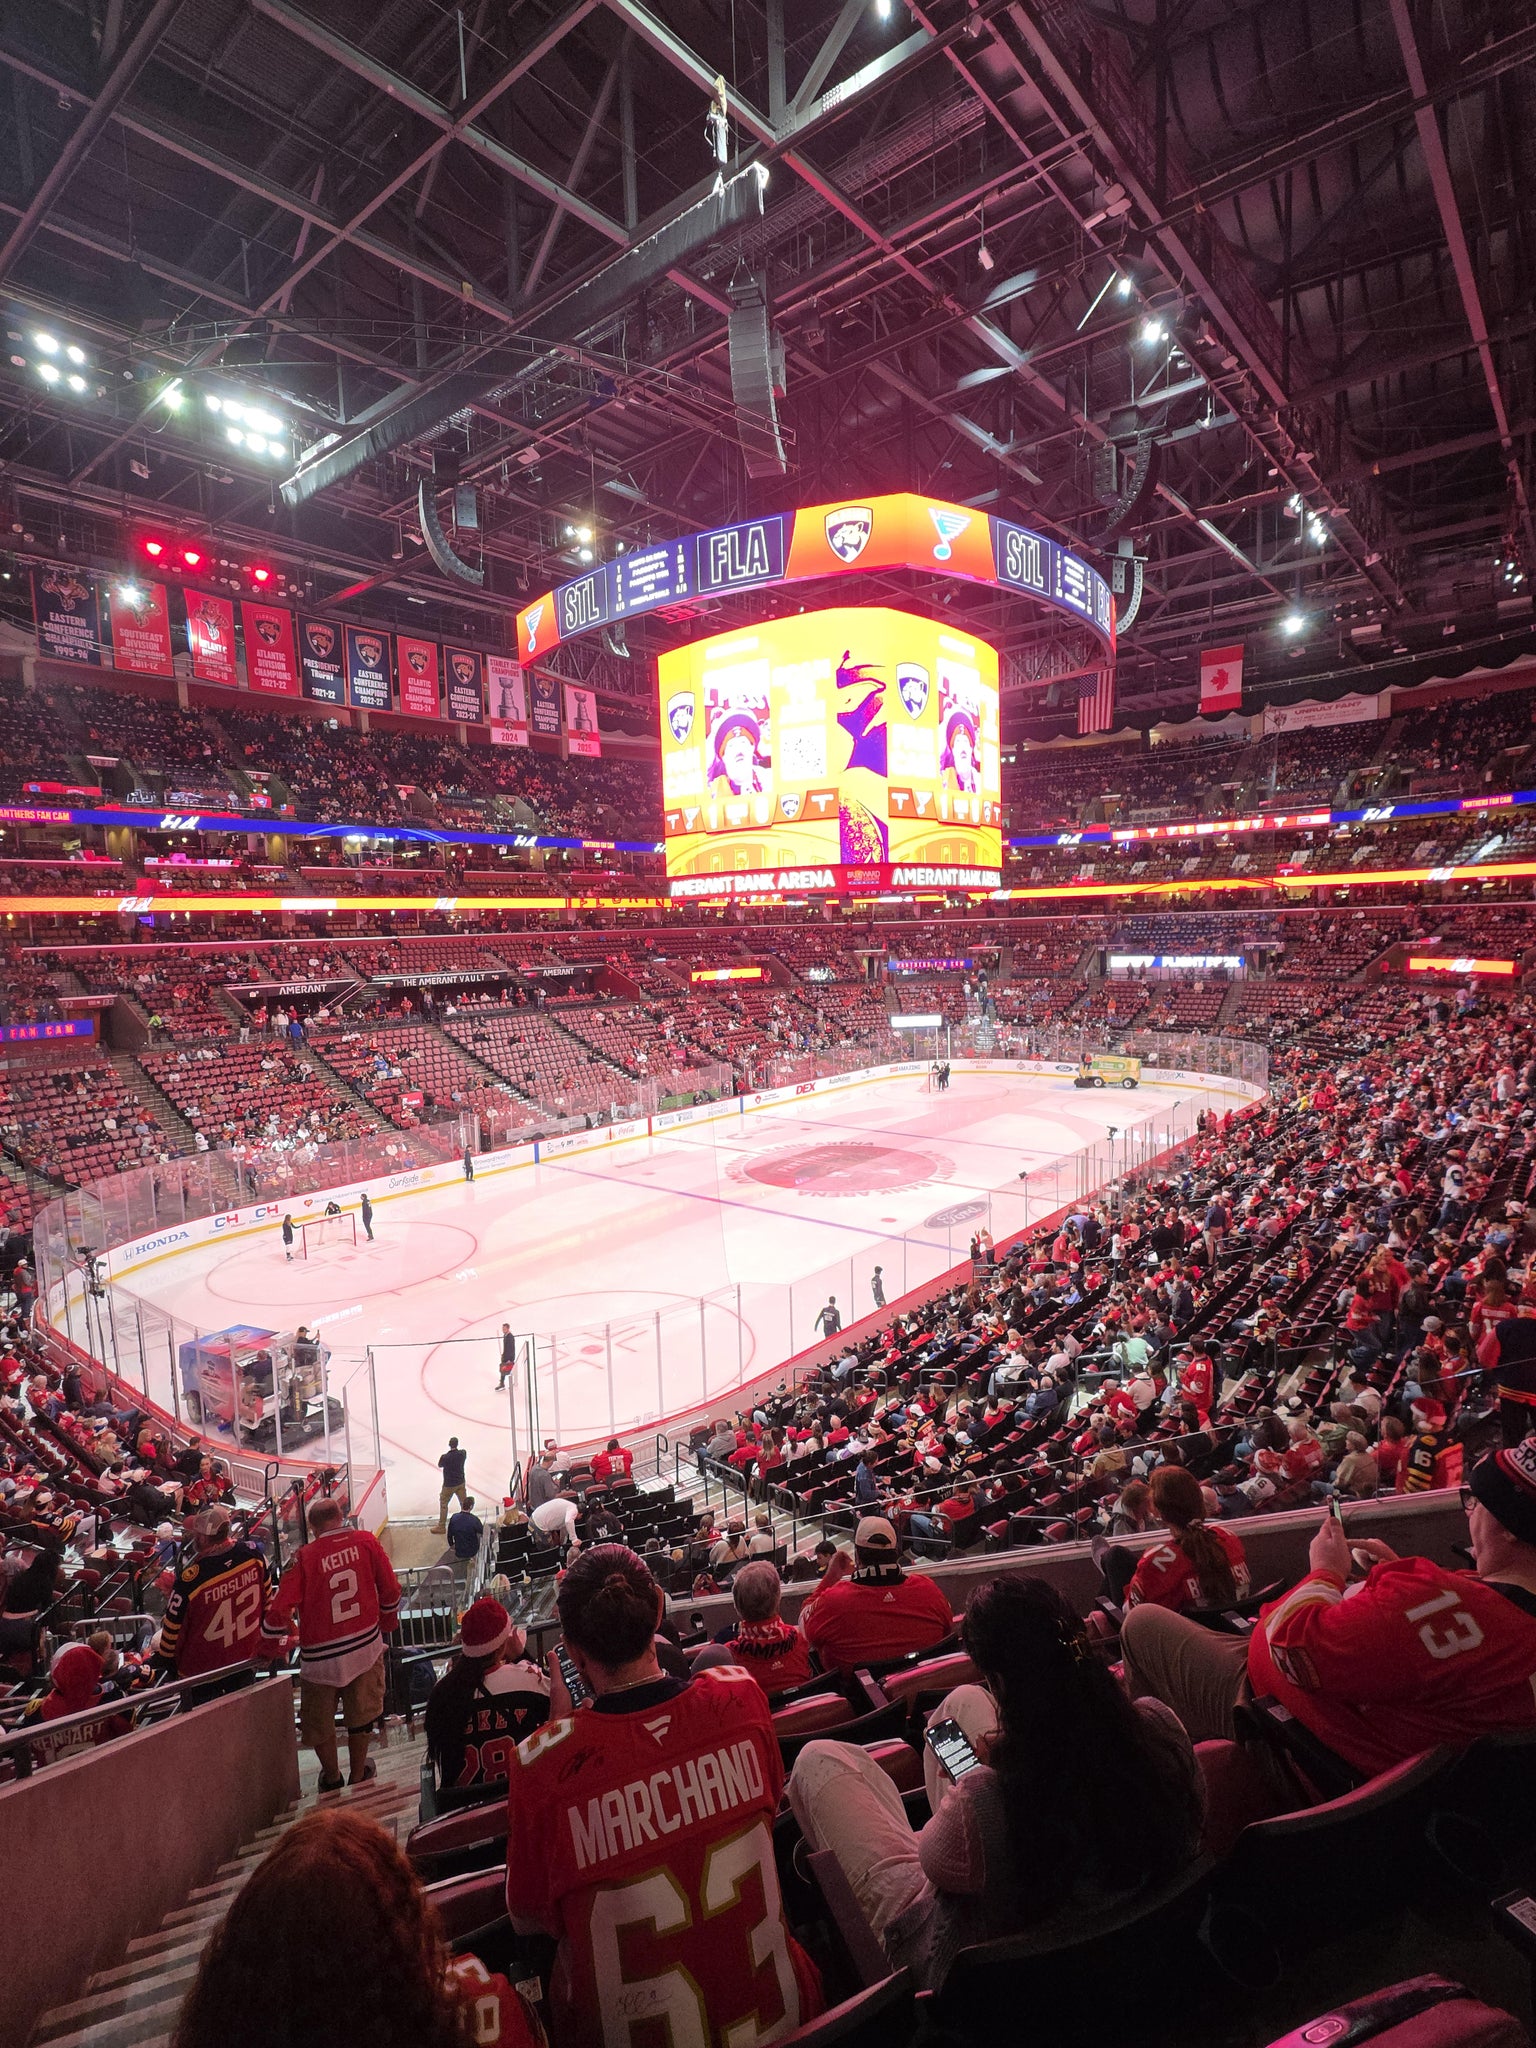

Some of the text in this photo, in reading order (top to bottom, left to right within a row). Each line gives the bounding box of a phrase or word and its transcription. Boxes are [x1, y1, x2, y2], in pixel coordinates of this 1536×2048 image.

[710, 525, 770, 584] FLA
[1006, 530, 1044, 588] STL
[564, 577, 600, 630] STL
[49, 612, 87, 627] EASTERN
[42, 622, 94, 639] CONFERENCE
[120, 628, 164, 642] SOUTHEAST
[54, 645, 88, 659] 1995-96
[125, 639, 160, 651] DIVISION
[256, 649, 286, 661] ATLANTIC
[258, 658, 286, 670] DIVISION
[303, 658, 340, 672] PRESIDENTS'
[254, 668, 292, 680] CHAMPIONS
[358, 670, 383, 680] EASTERN
[261, 678, 287, 690] 2021-22
[354, 677, 388, 690] CONFERENCE
[408, 678, 432, 688] ATLANTIC
[312, 687, 336, 700] 2021-22
[354, 686, 388, 698] CHAMPIONS
[408, 685, 432, 696] DIVISION
[454, 686, 476, 696] EASTERN
[360, 695, 384, 706] 2022-23
[405, 694, 436, 704] CHAMPIONS
[450, 694, 480, 704] CONFERENCE
[451, 702, 480, 712] CHAMPIONS
[1294, 704, 1334, 715] UNRULY
[501, 732, 519, 742] 2024
[577, 742, 592, 752] 2025
[36, 810, 52, 821] FAN
[52, 810, 70, 822] CAM
[670, 870, 836, 897] AMERANT BANK ARENA
[891, 868, 958, 886] AMERANT
[542, 968, 575, 977] AMERANT
[402, 974, 485, 987] THE AMERANT VAULT
[279, 984, 328, 996] AMERANT
[10, 1024, 76, 1040] FAN CAM
[796, 1082, 816, 1096] DEX
[388, 1174, 419, 1189] Surfside
[255, 1204, 278, 1218] CH
[936, 1205, 983, 1225] Ford
[214, 1214, 238, 1228] CH
[136, 1231, 190, 1256] HONDA
[1414, 1449, 1432, 1468] 16
[322, 1546, 360, 1574] KEITH
[204, 1568, 259, 1605] FORSLING
[328, 1568, 361, 1625] 2
[203, 1584, 261, 1649] 42
[1405, 1589, 1485, 1660] 13
[567, 1739, 764, 1870] MARCHAND
[590, 1820, 803, 2048] 63
